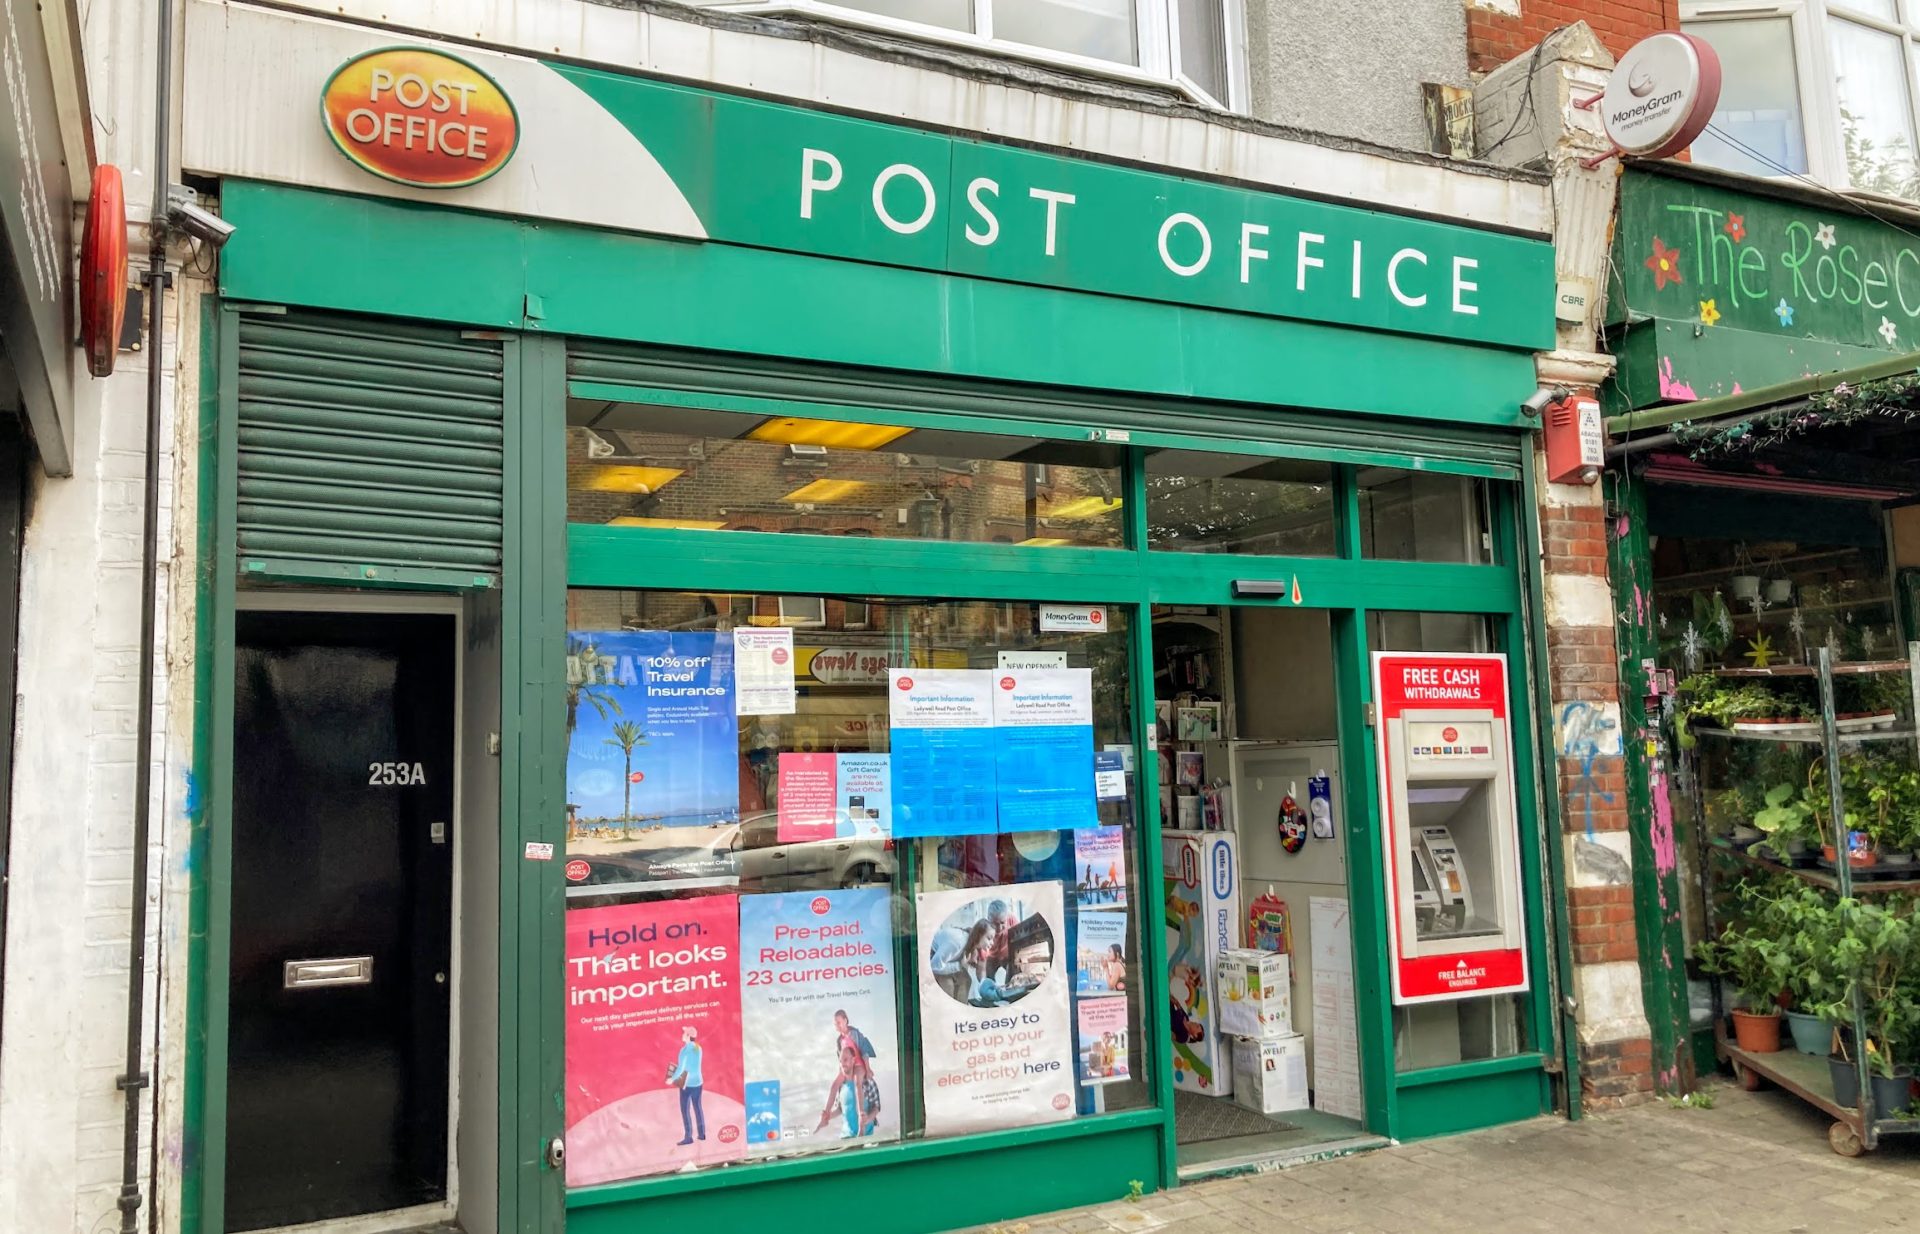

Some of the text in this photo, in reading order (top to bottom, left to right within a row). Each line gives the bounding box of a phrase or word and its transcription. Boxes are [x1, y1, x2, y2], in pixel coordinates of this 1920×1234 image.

[370, 68, 476, 116] POST
[1612, 90, 1682, 125] MoneyGram
[1621, 106, 1671, 131] money transfer
[346, 108, 487, 160] OFFICE
[800, 148, 1479, 315] POST OFFICE
[1667, 204, 1768, 309] The
[1561, 294, 1585, 306] CBRE
[1046, 612, 1088, 621] MoneyGram
[647, 657, 680, 668] 10%
[647, 671, 694, 682] Travel
[1403, 668, 1480, 685] FREE CASH
[648, 686, 726, 696] Insurance
[1404, 687, 1480, 700] WITHDRAWALS
[368, 762, 426, 785] 253A
[588, 922, 708, 948] Hold on.
[775, 920, 864, 941] Pre-paid.
[569, 944, 728, 978] That looks
[760, 941, 876, 963] Reloadable.
[747, 962, 888, 986] 23 currencies.
[1438, 968, 1486, 980] FREE BALANCE
[1448, 978, 1477, 988] ENQUIRIES
[571, 970, 728, 1006] important.
[609, 1013, 622, 1022] day
[623, 1009, 657, 1020] guaranteed
[658, 1006, 683, 1015] delivery
[611, 1022, 625, 1030] your
[626, 1018, 656, 1028] important
[954, 1013, 1040, 1034] It's easy to
[952, 1029, 1044, 1052] top up your
[966, 1045, 1030, 1068] gas and
[937, 1060, 1060, 1087] electricity here
